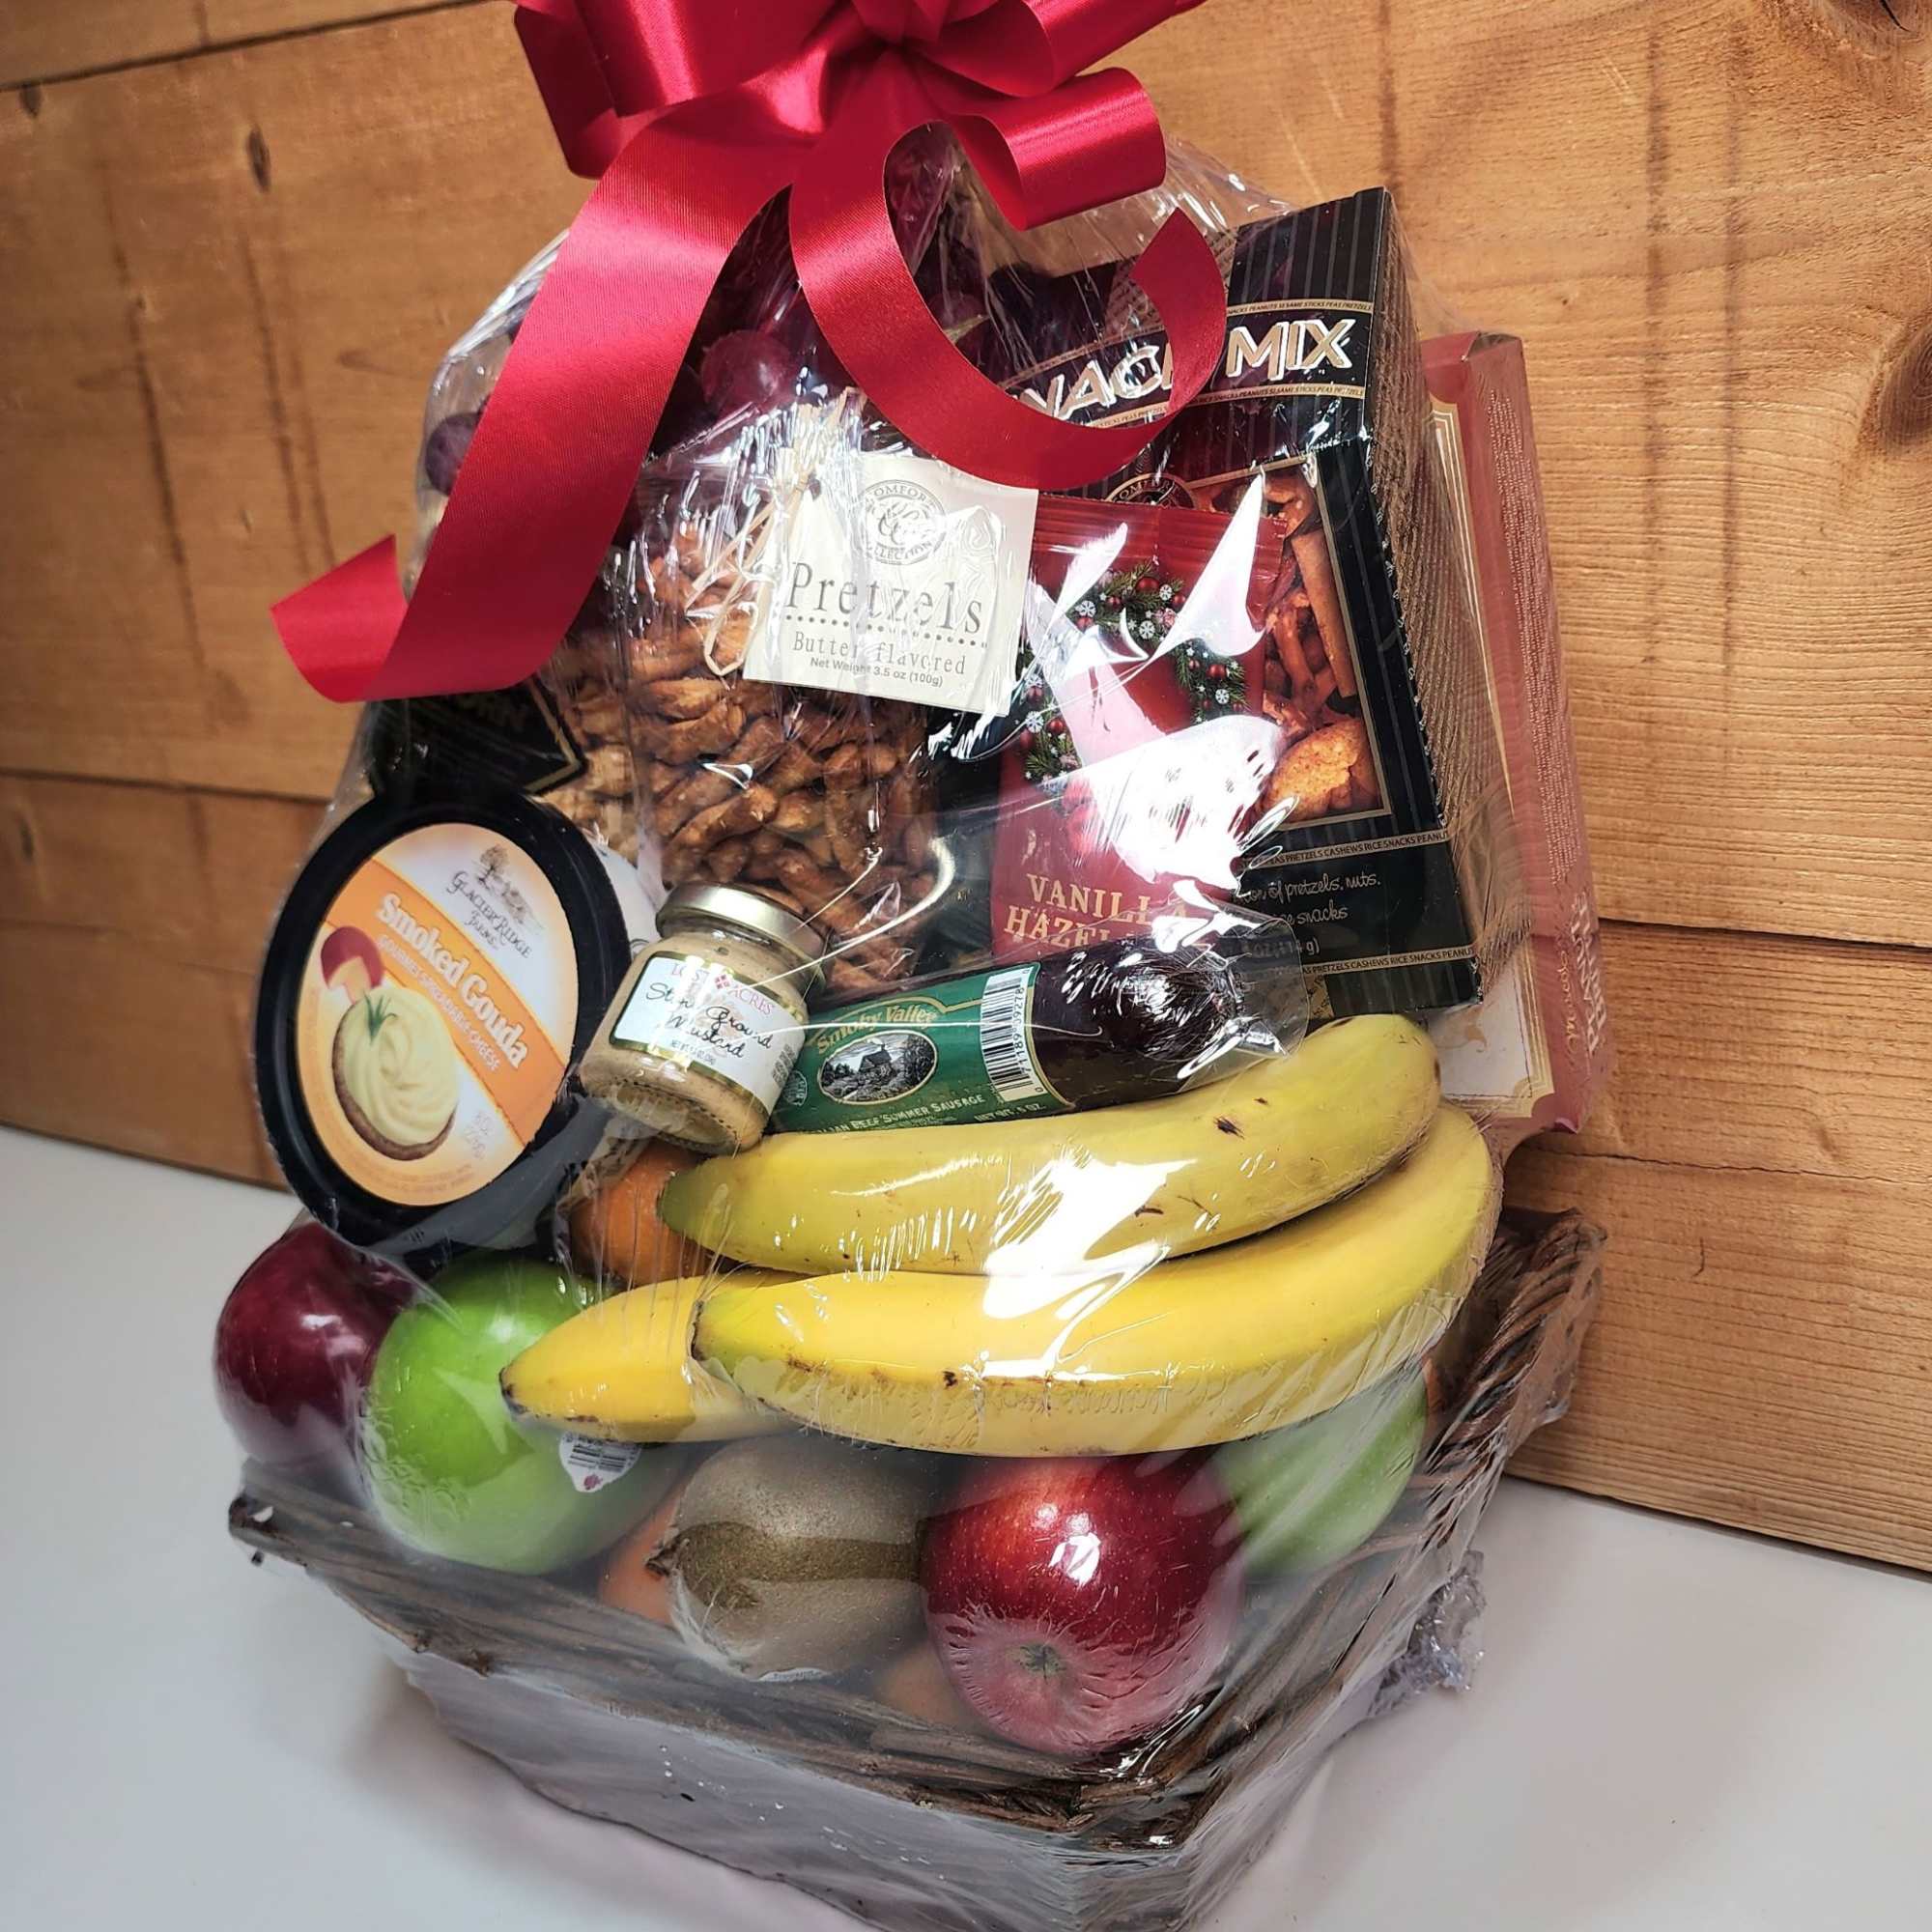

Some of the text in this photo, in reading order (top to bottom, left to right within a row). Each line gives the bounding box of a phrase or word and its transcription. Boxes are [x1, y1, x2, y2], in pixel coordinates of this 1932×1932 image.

[1226, 319, 1356, 382] MIX
[867, 484, 934, 505] OMFOR
[785, 562, 981, 634] Pretzels
[793, 631, 966, 674] Butter flavored
[810, 657, 830, 669] Net
[873, 666, 891, 677] 3.5
[894, 670, 906, 680] oz
[909, 672, 943, 687] (100g)
[1287, 849, 1323, 865] PRETZELS
[1323, 844, 1364, 859] CASHEWS
[1365, 840, 1383, 852] RICE
[1383, 838, 1416, 849] SNACKS
[1297, 899, 1349, 925] snacks
[1312, 962, 1351, 974] PRETZELS
[1351, 957, 1389, 970] CASHEWS
[1390, 955, 1407, 964] RICE
[1408, 952, 1441, 963] SNACKS
[378, 893, 528, 1068] Smoked Gouda
[468, 1029, 500, 1071] CHEESE
[882, 1106, 930, 1123] SUMMER
[931, 1094, 985, 1113] SAUSAGE
